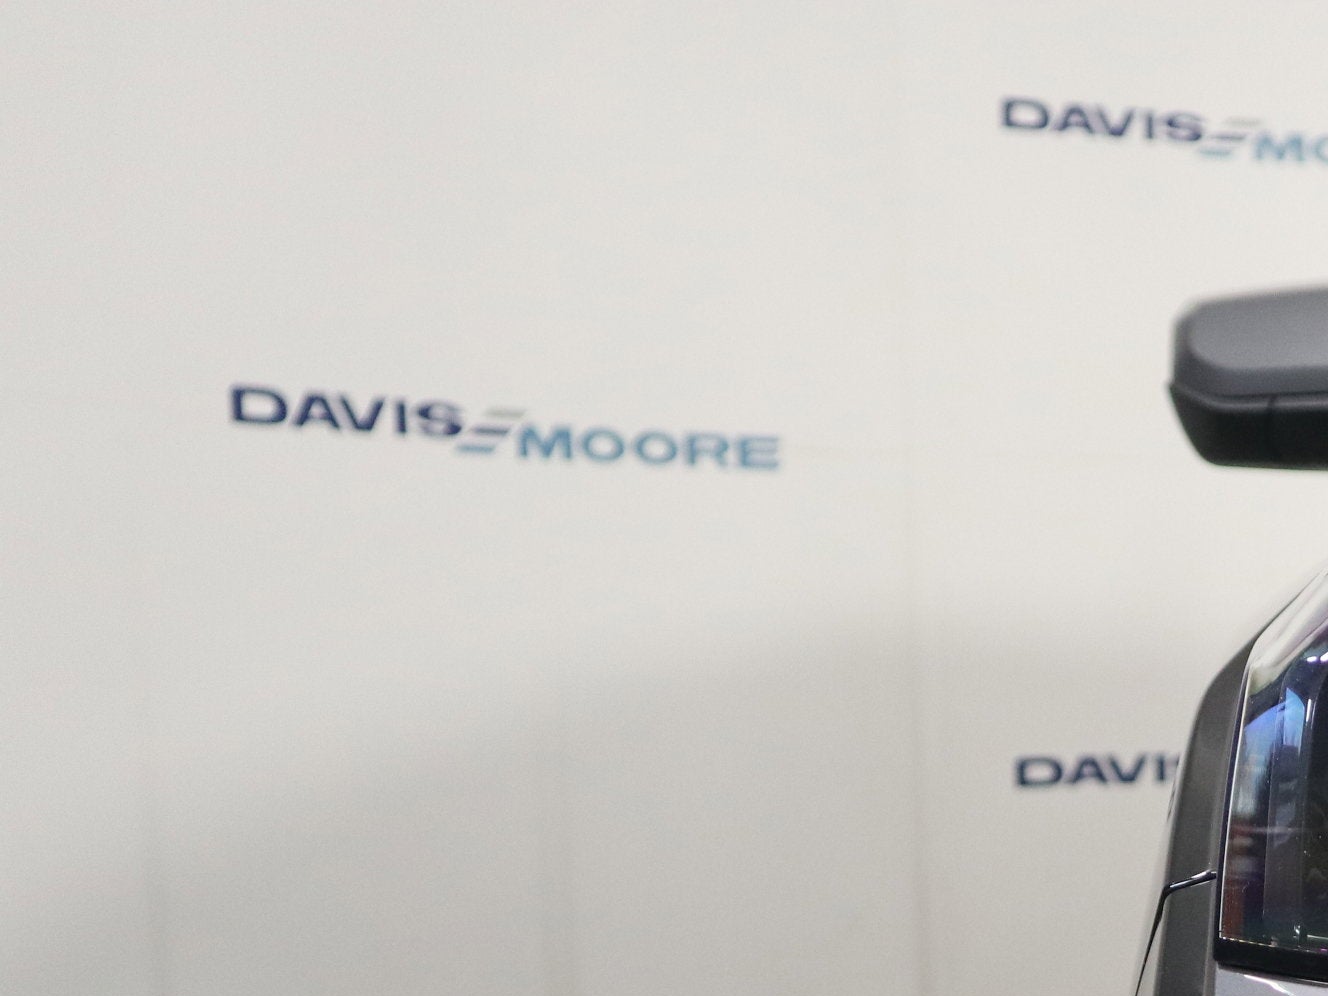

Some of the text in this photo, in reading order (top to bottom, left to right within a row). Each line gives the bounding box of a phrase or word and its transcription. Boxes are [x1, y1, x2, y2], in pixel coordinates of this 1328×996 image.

[1001, 97, 1204, 144] DAVIS
[230, 384, 781, 470] DAVIS MOORE
[1016, 755, 1180, 786] DAVI
